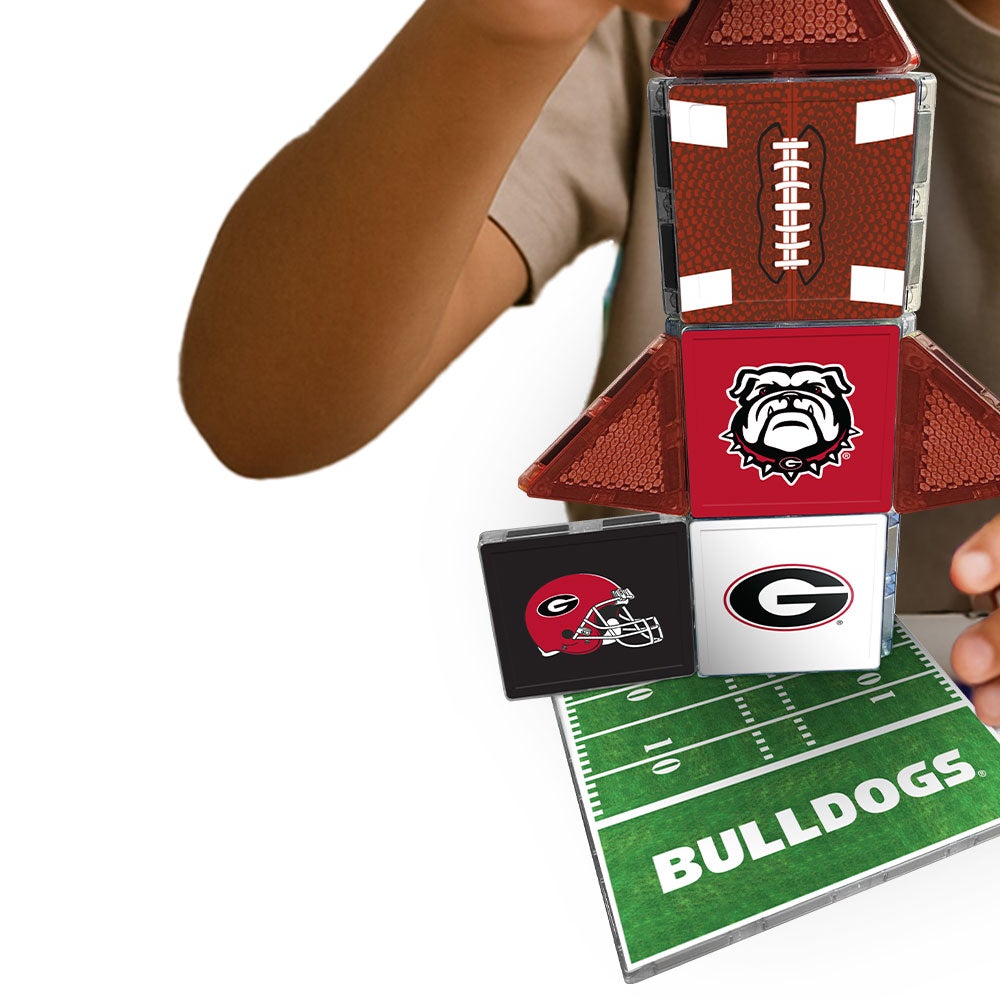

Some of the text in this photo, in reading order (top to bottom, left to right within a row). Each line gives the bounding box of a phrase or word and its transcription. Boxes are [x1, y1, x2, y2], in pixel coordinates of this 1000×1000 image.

[537, 594, 580, 618] G
[728, 567, 849, 628] G
[652, 748, 977, 895] BULLDOGS
